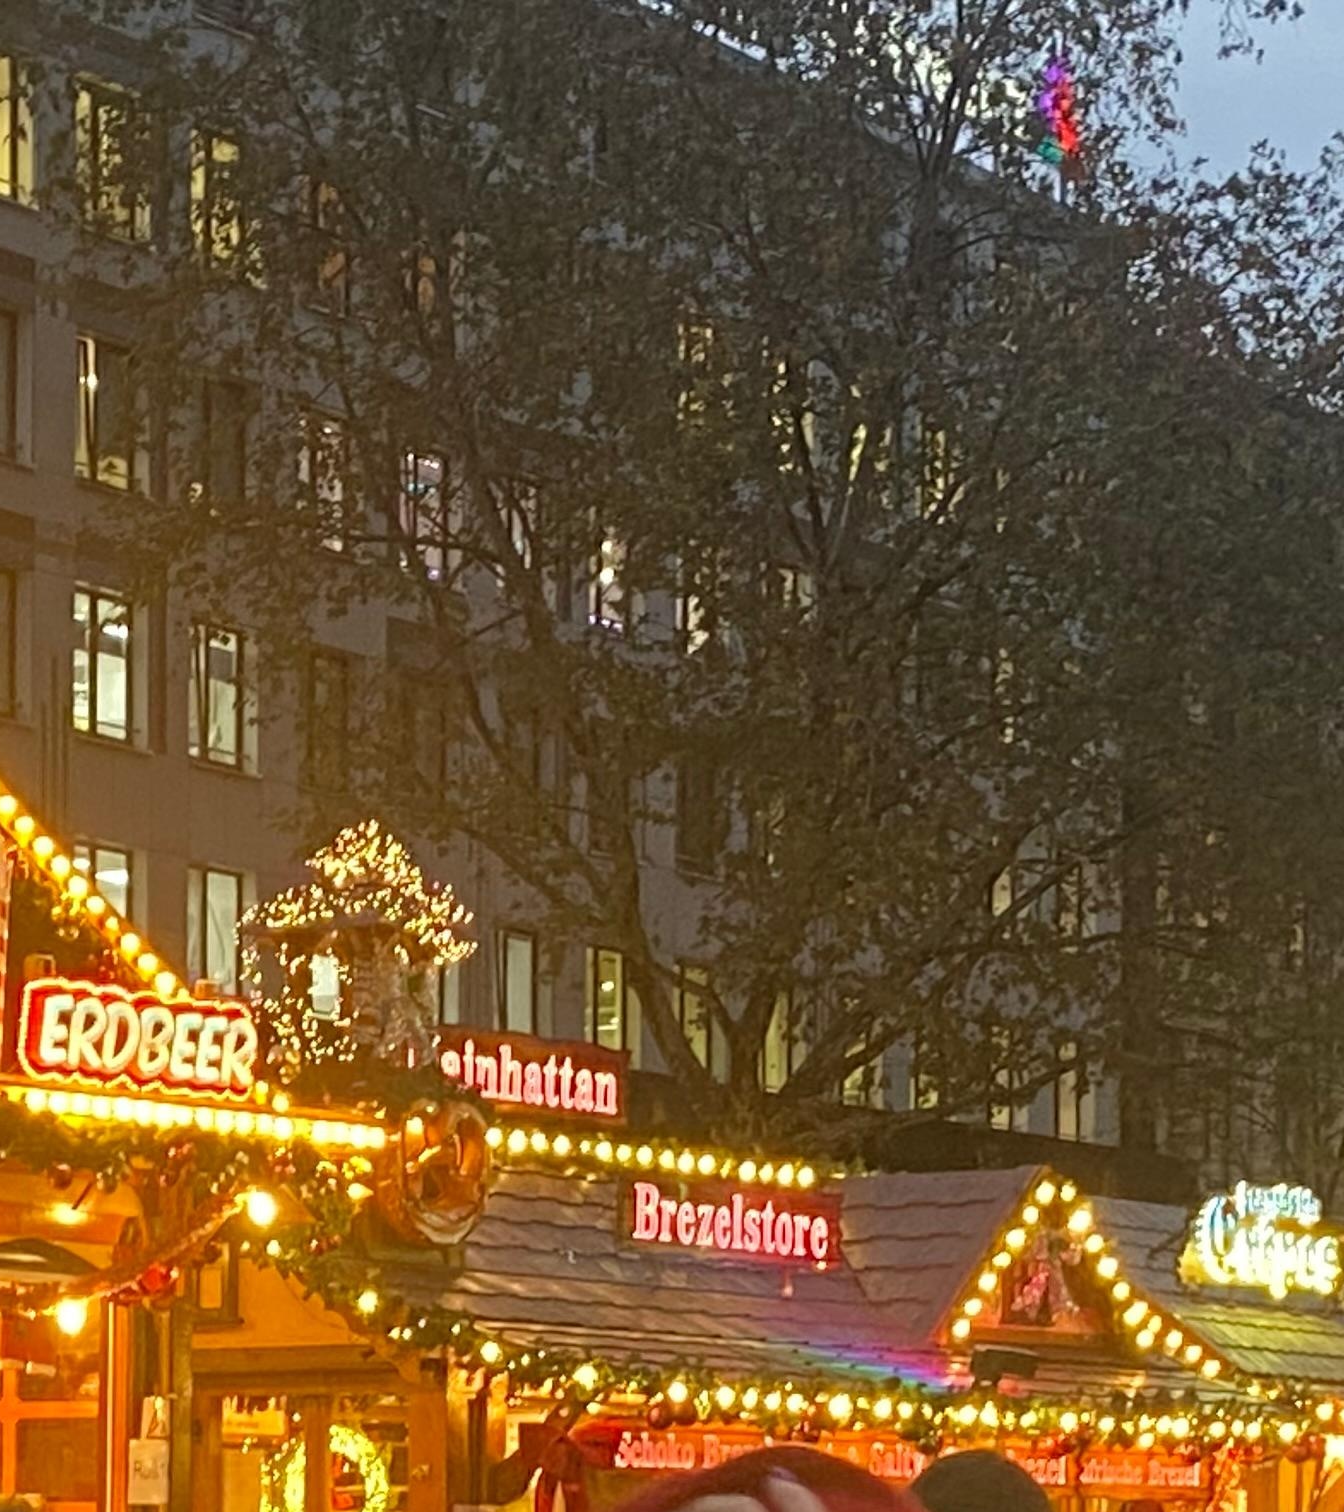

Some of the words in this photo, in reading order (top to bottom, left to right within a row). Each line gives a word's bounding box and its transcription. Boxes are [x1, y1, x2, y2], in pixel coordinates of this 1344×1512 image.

[39, 994, 258, 1086] ERDBEER
[632, 1182, 828, 1259] Brezelstore
[615, 1431, 695, 1468] Schoko
